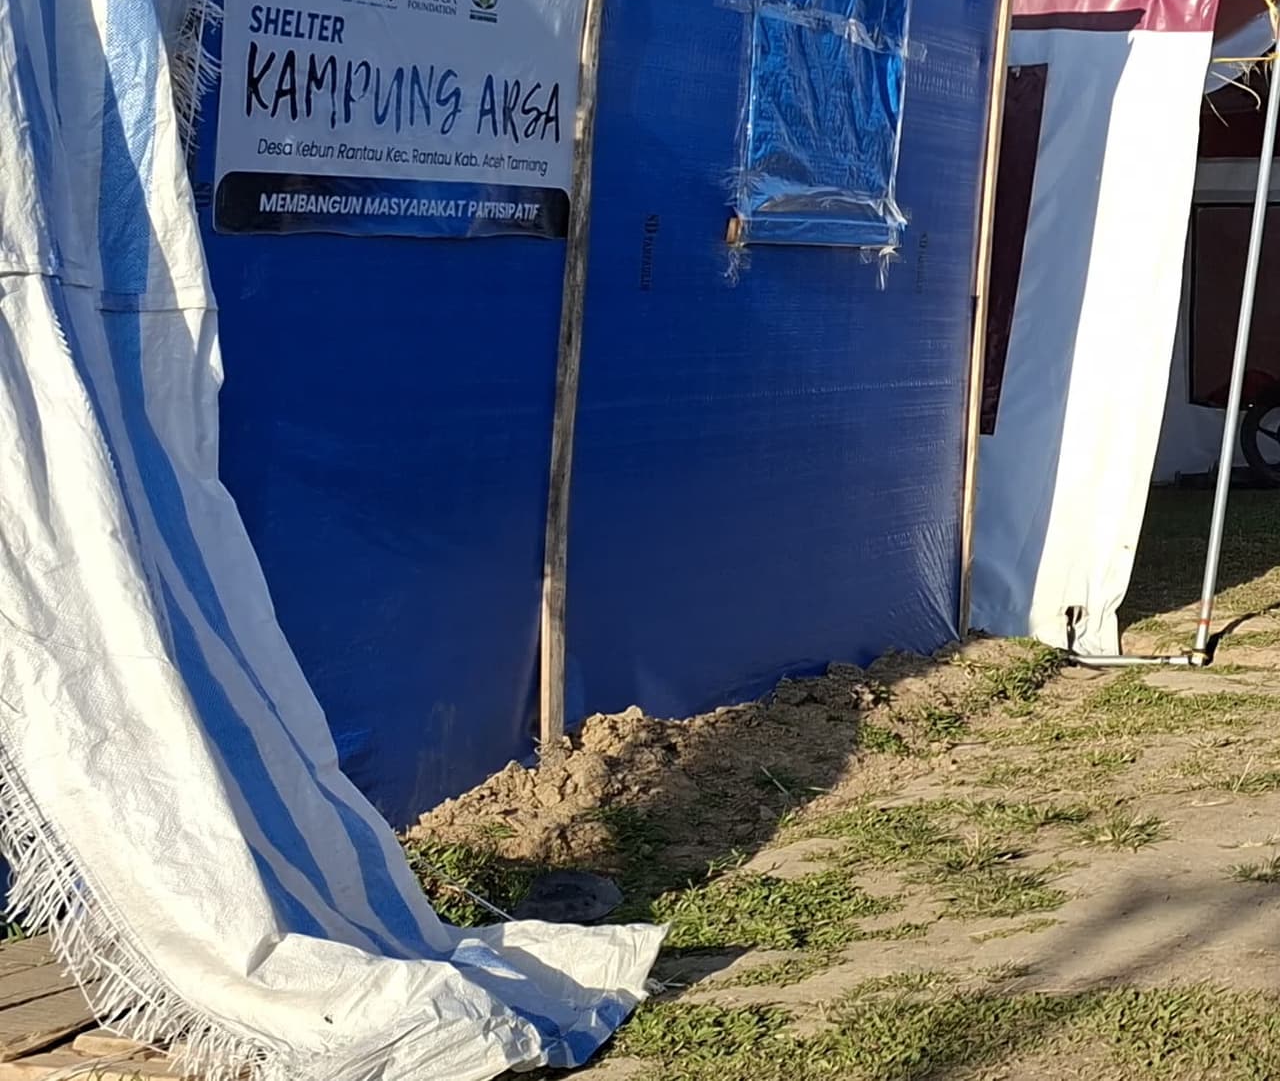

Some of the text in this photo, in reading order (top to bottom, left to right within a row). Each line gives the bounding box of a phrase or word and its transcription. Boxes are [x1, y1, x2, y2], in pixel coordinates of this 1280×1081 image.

[249, 5, 345, 44] SHELTER
[408, 0, 456, 16] FOUNDATION
[246, 41, 560, 143] KAMPUNG ARSA
[257, 138, 548, 177] Desa Kebun Rantau Kec. Rantau Kab. Aceh Tamiang
[260, 193, 541, 221] MEMBANGUN MASYARAKAT PARTISIPATIF
